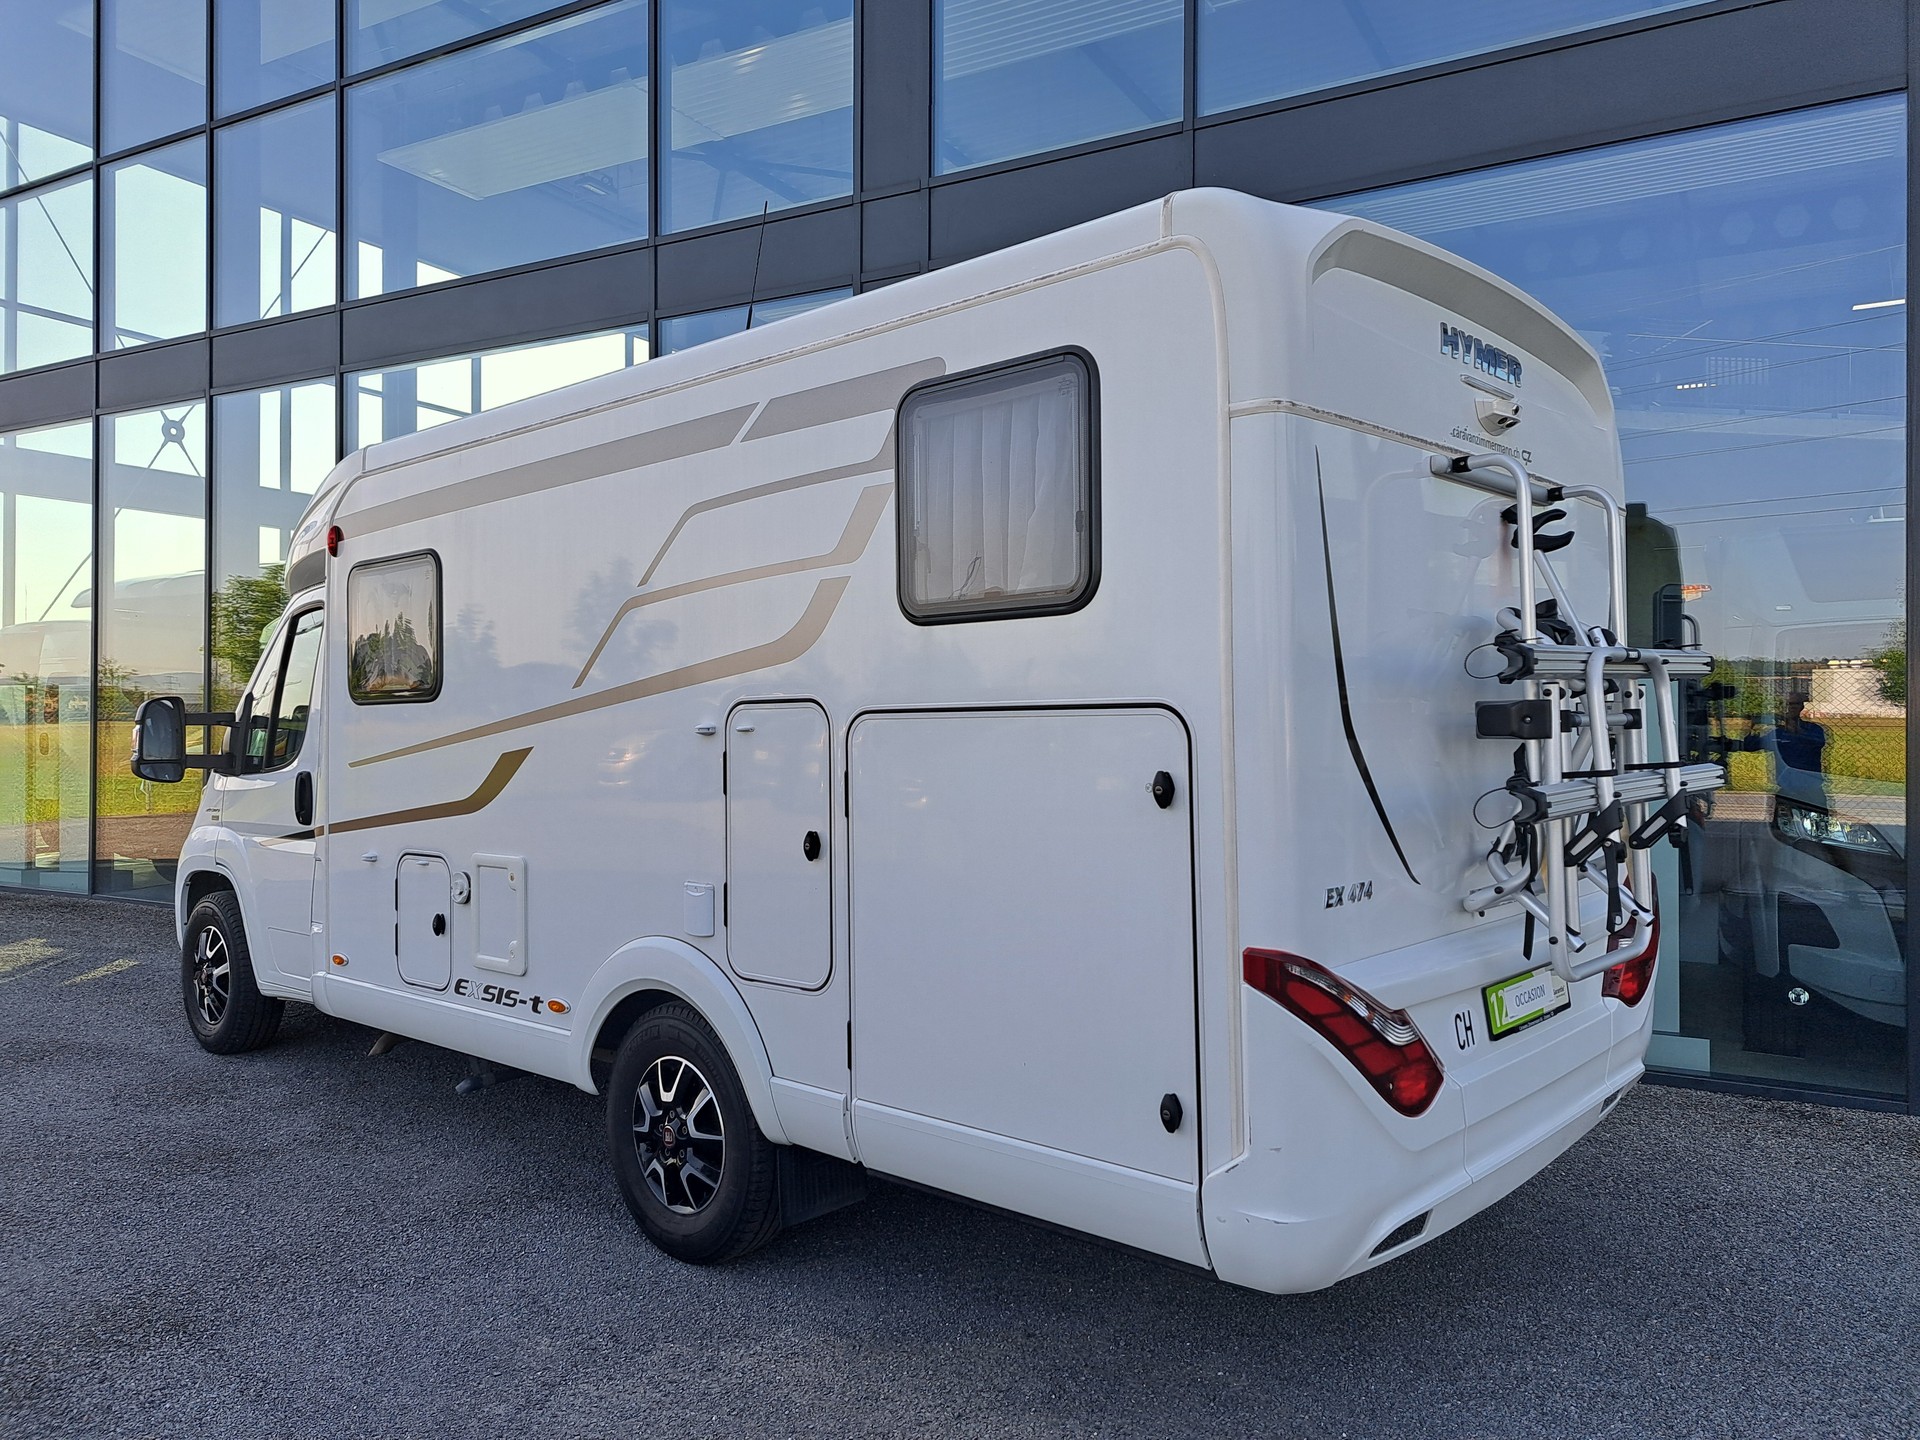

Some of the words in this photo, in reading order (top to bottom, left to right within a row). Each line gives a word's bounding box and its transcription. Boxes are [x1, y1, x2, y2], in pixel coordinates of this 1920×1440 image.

[1440, 322, 1523, 388] HYMER
[1324, 886, 1345, 909] EX
[1347, 880, 1373, 903] 474
[454, 978, 544, 1014] EXSIS-t
[1514, 984, 1546, 1008] OCCASION
[1454, 1009, 1476, 1051] CH
